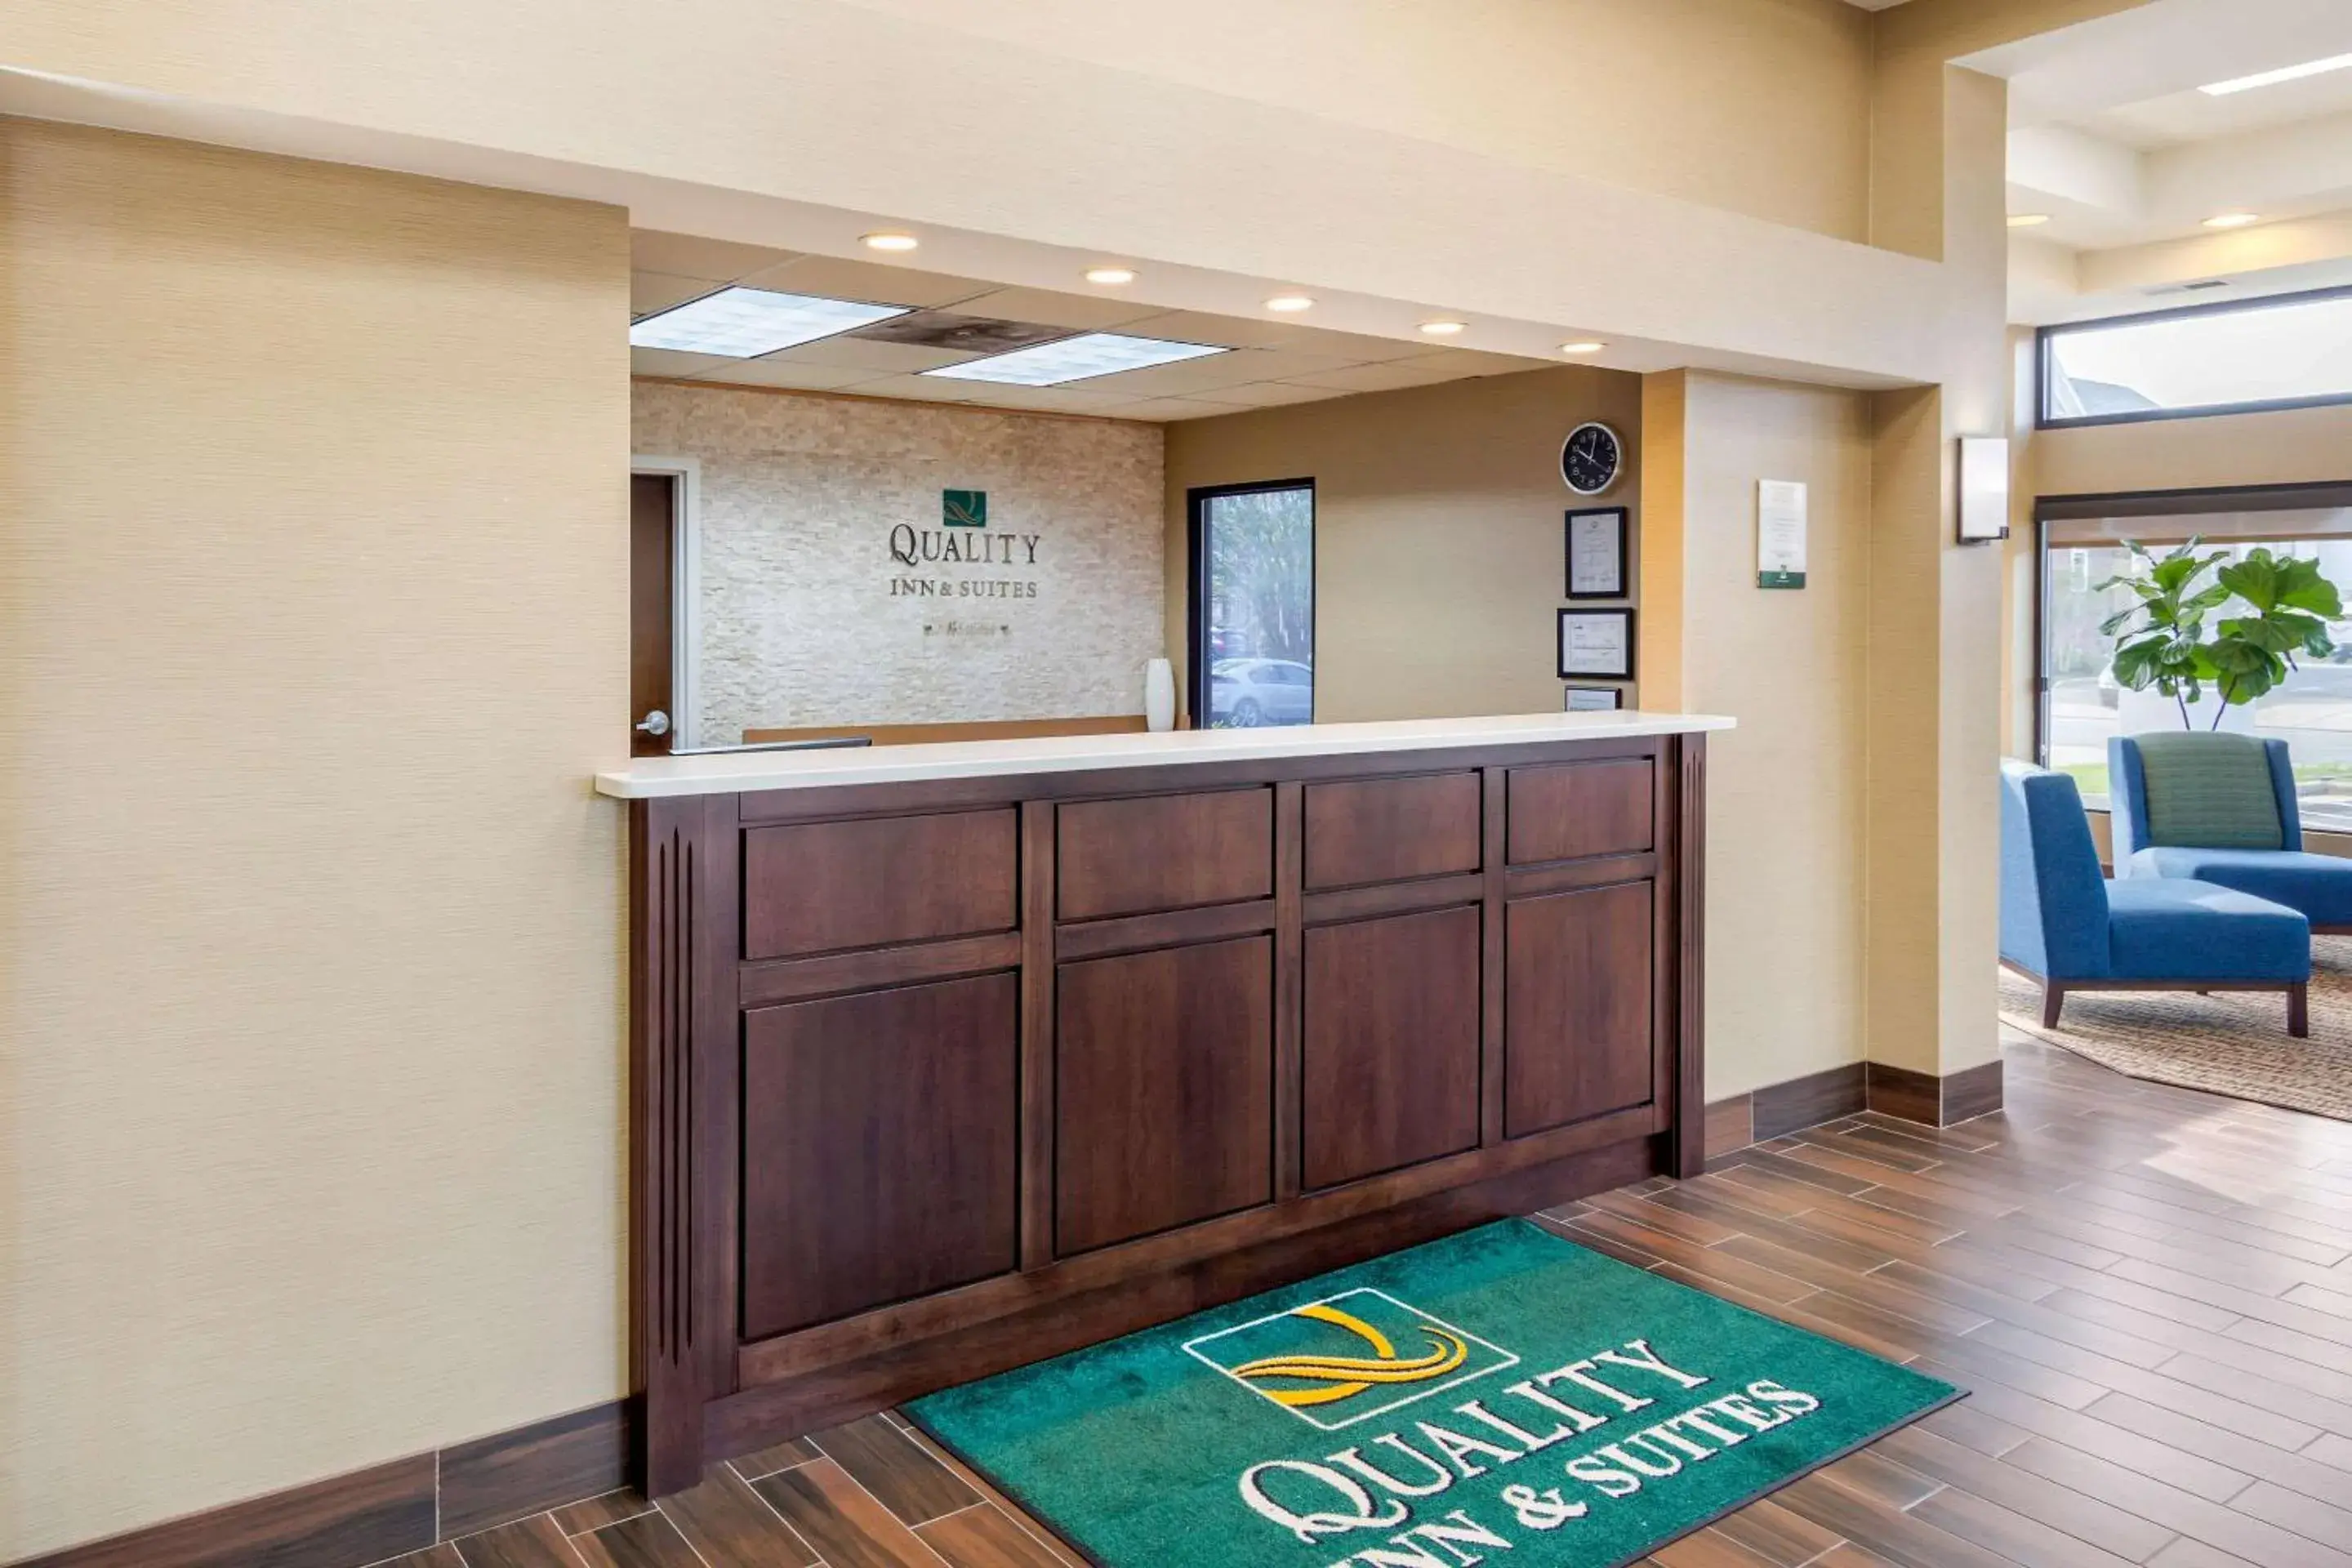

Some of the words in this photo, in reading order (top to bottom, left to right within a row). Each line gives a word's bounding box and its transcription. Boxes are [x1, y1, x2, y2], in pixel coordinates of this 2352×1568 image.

[890, 523, 1041, 567] QUALITY
[890, 579, 935, 596] INN
[940, 581, 953, 596] &
[960, 580, 1038, 599] SUITES
[1239, 1339, 1713, 1544] QUALITY
[1502, 1482, 1588, 1530] &
[1566, 1379, 1823, 1498] SUITES
